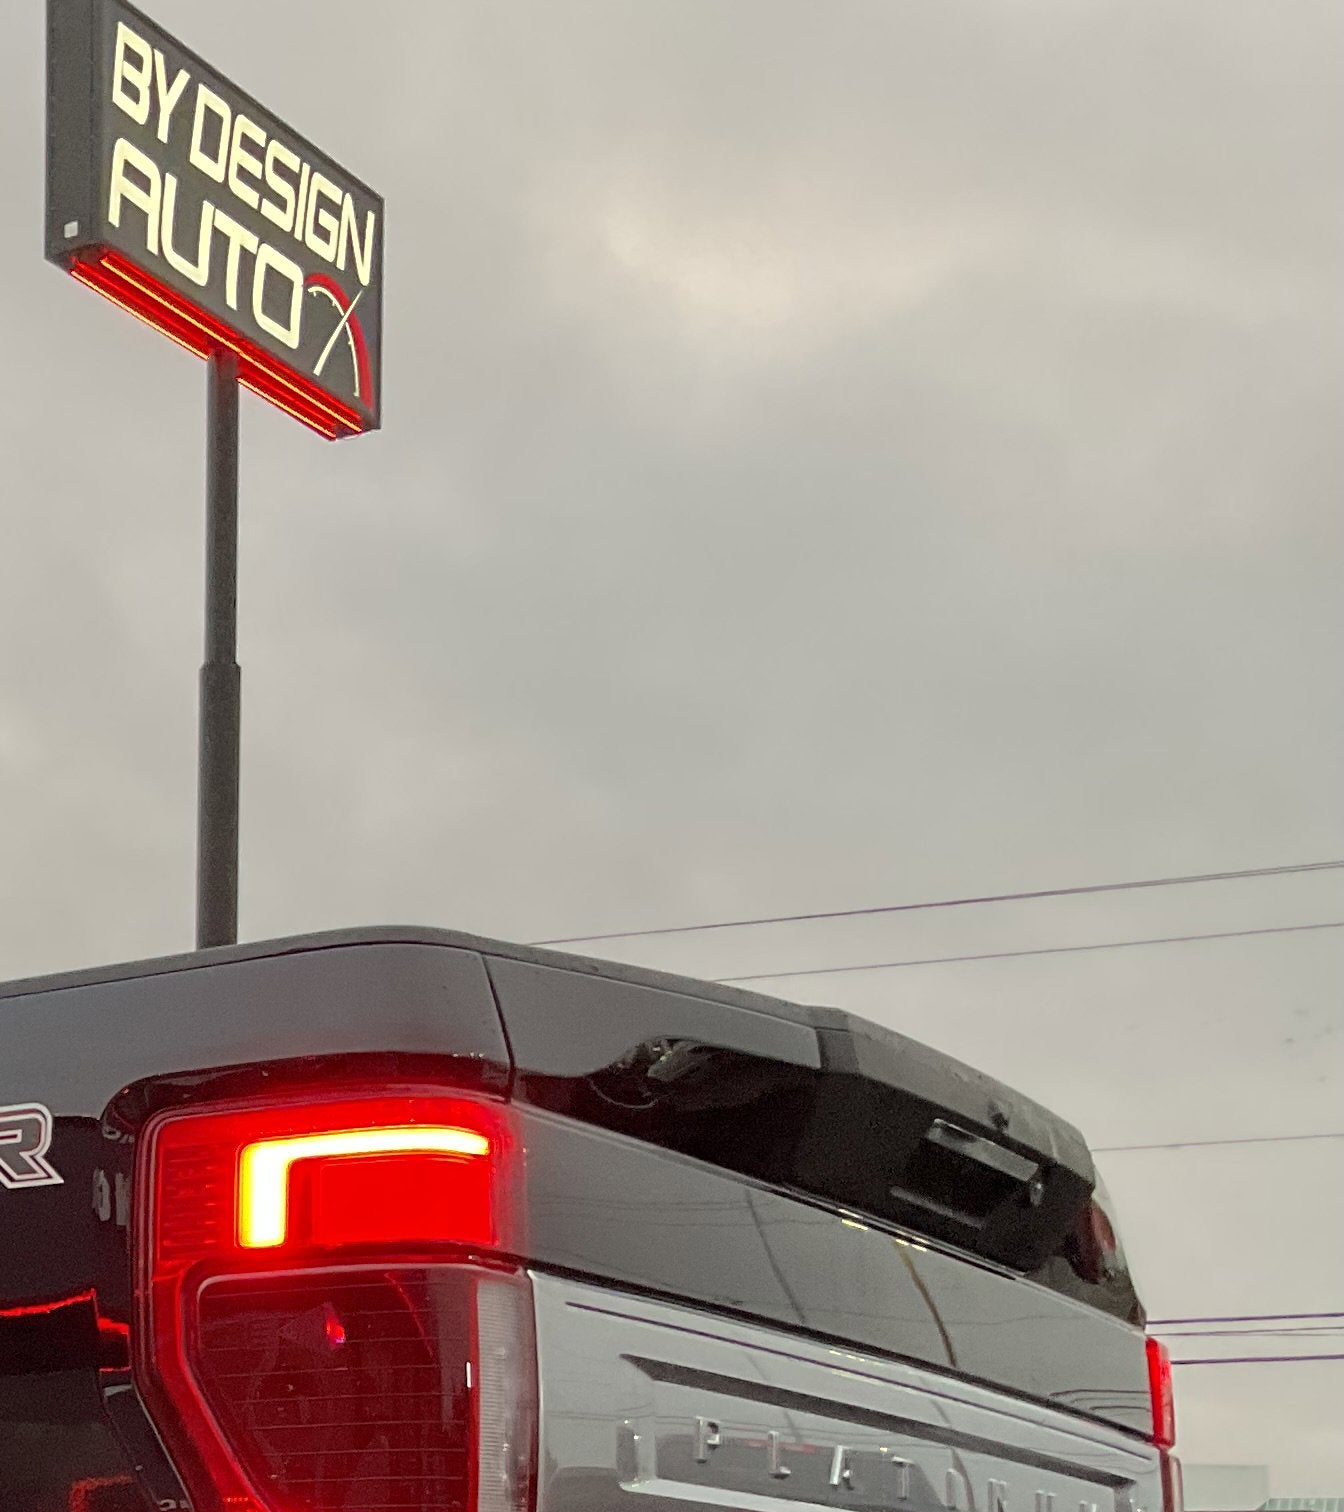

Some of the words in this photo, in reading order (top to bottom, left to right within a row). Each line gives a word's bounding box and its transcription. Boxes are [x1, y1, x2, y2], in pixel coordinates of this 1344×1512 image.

[108, 137, 304, 350] AUTO
[112, 21, 190, 144] BY
[189, 83, 375, 287] DESIGN
